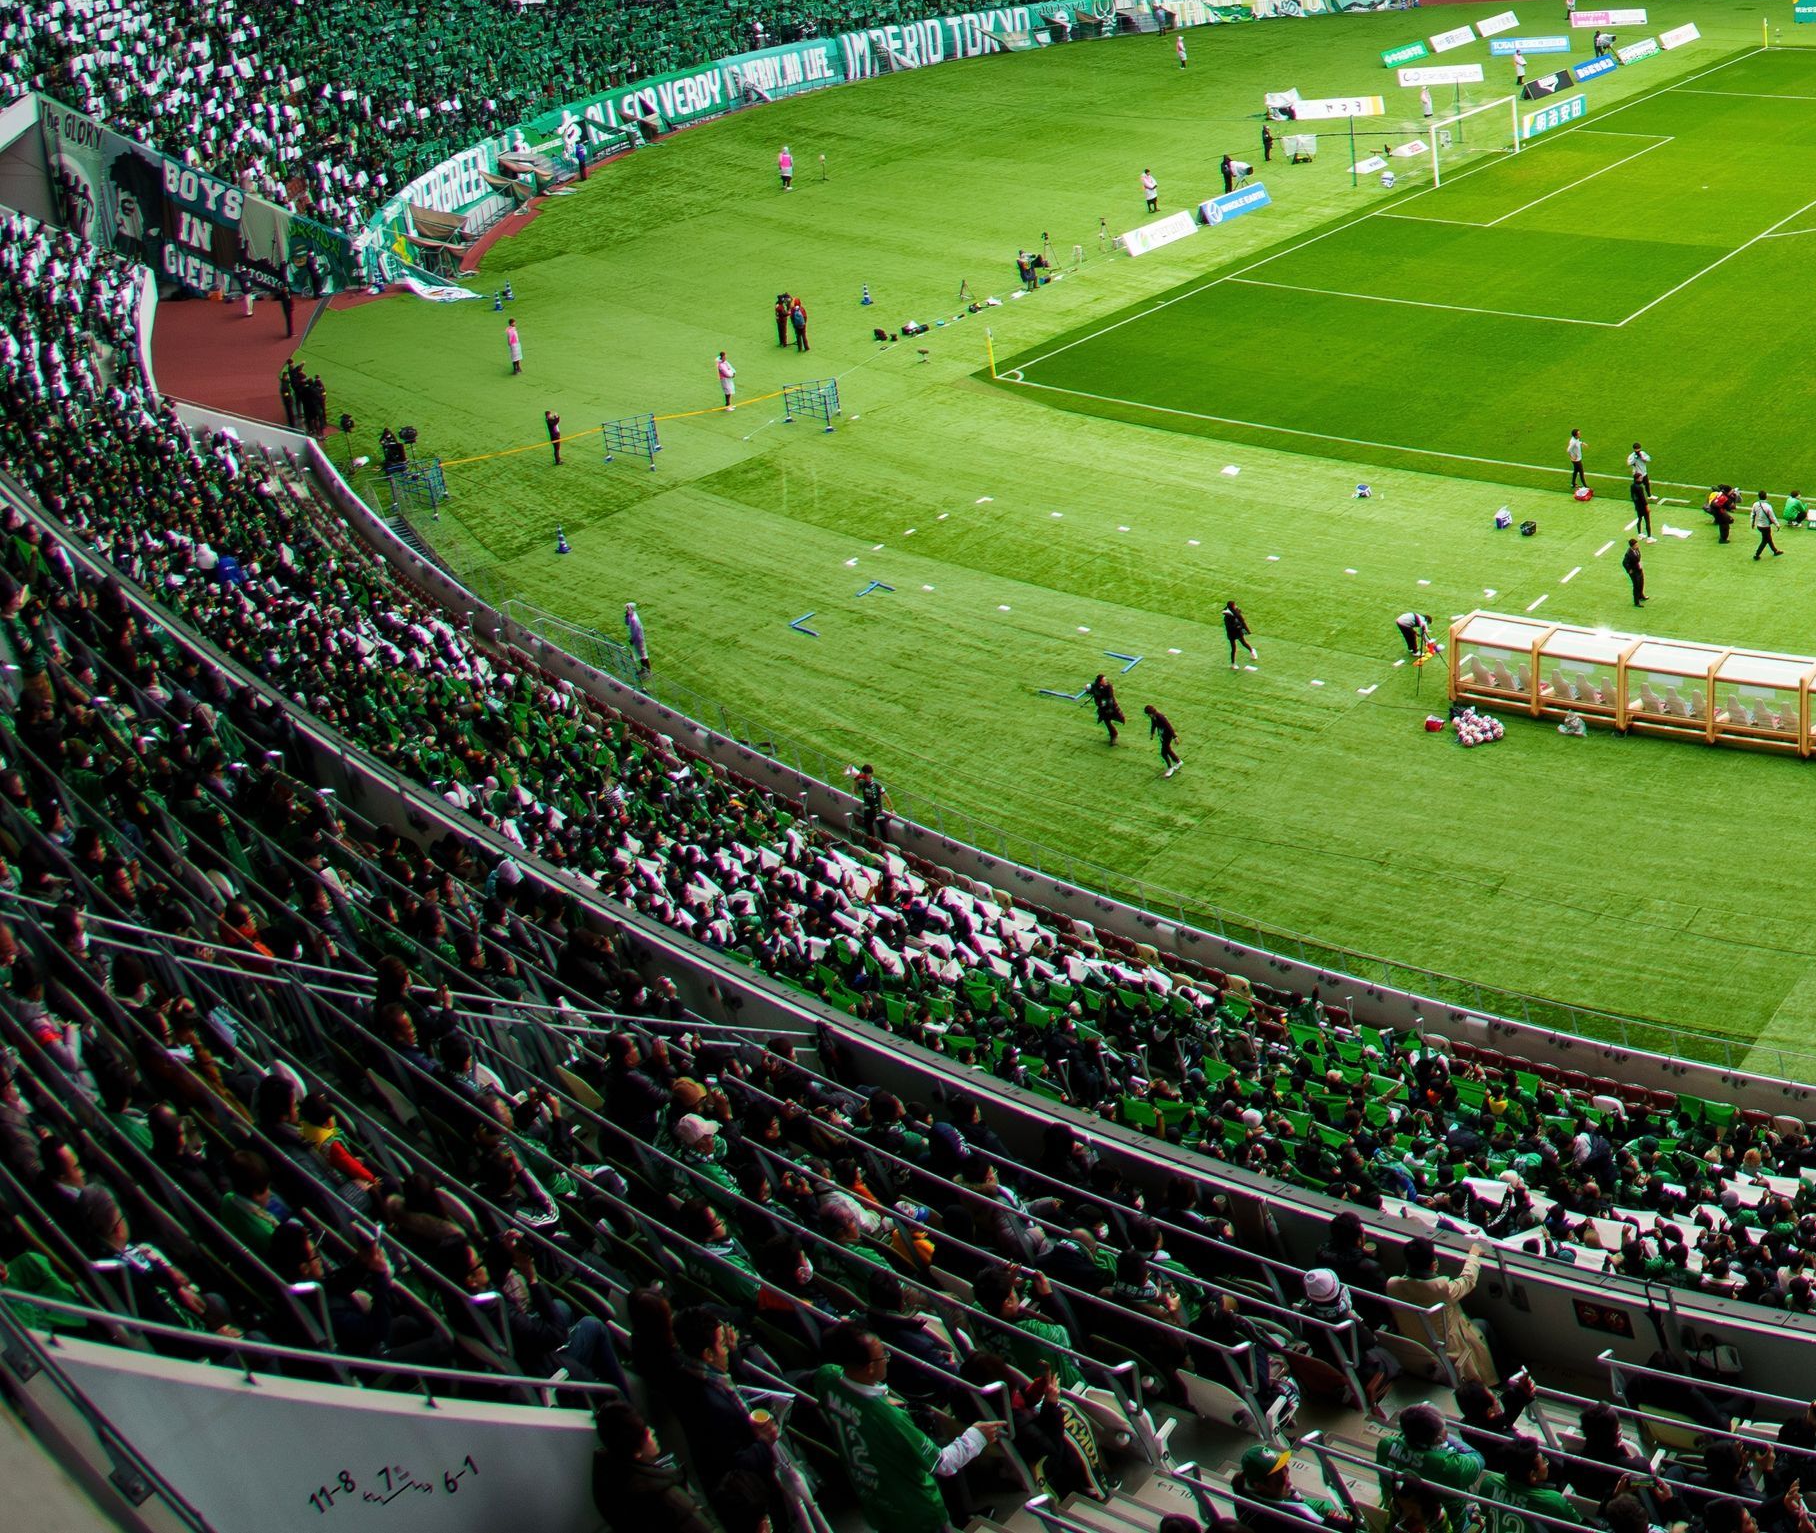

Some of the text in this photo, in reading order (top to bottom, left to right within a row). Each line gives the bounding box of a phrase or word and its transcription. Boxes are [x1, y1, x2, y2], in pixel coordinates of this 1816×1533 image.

[805, 45, 838, 81] LIFE
[660, 71, 723, 121] VERDY
[1536, 99, 1582, 131] 明治安田
[63, 112, 104, 150] GLORY
[164, 161, 244, 222] BOYS
[179, 211, 213, 252] IN
[1387, 1441, 1425, 1469] MJS
[309, 1455, 480, 1514] 11-8 6-1
[1491, 1483, 1529, 1509] MJS
